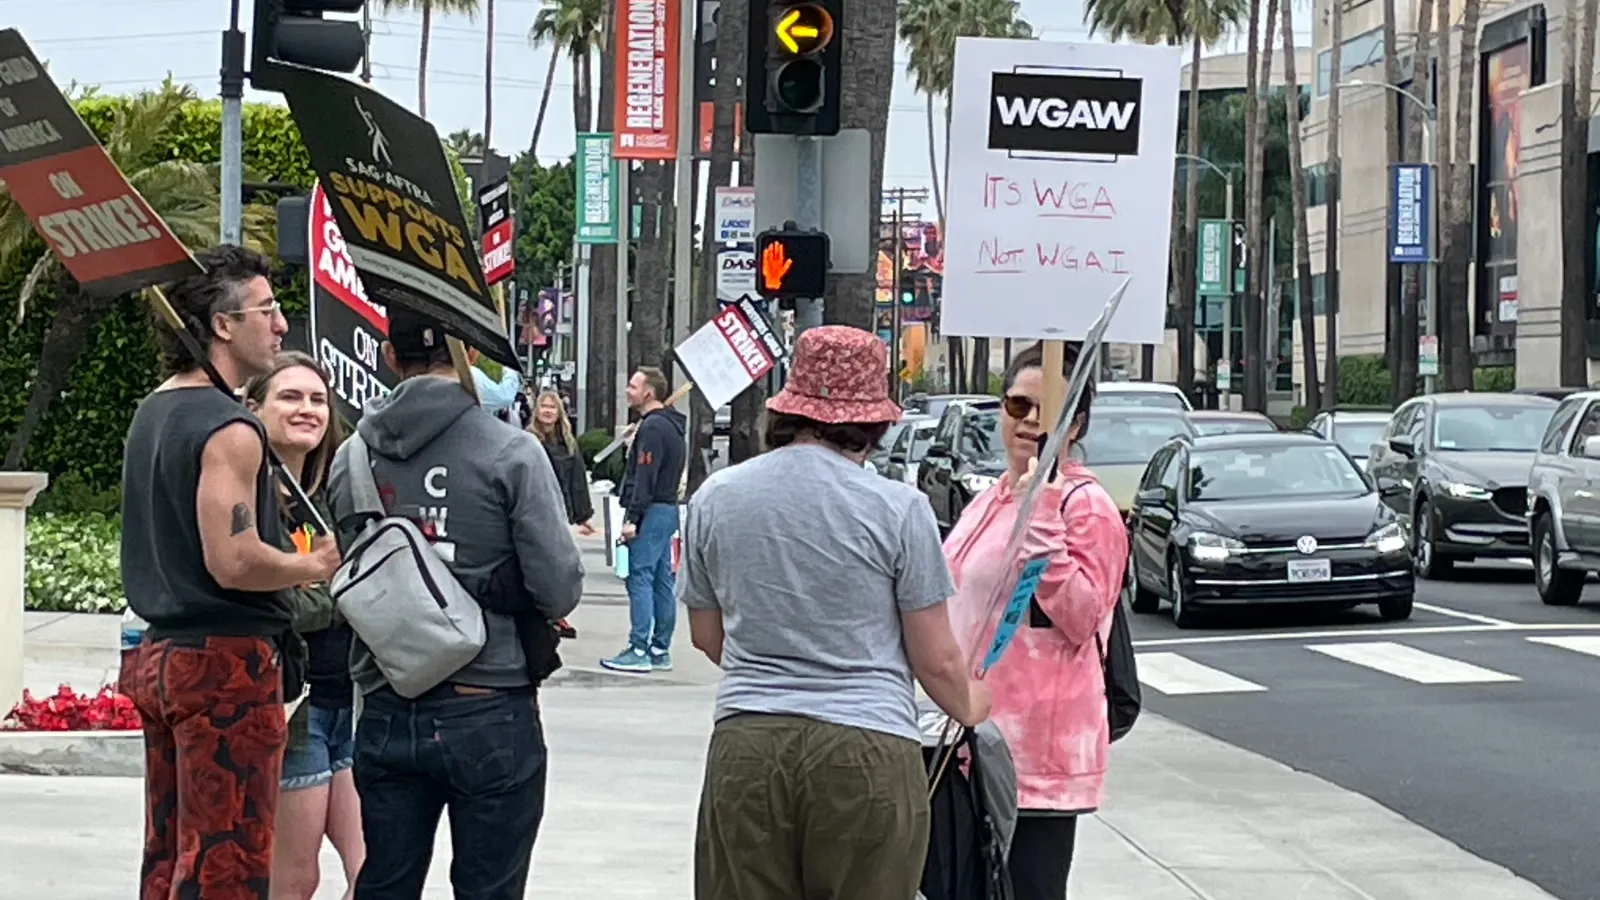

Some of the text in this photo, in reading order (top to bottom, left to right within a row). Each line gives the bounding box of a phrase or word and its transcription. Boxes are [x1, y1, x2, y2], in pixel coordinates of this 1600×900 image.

[995, 96, 1136, 131] WGAW
[49, 171, 84, 199] ON
[1033, 178, 1117, 215] WGA
[39, 194, 162, 258] STRIKE!
[329, 171, 465, 249] SUPPORTS
[336, 195, 483, 296] WGA
[722, 259, 757, 271] DAS
[354, 326, 379, 371] ON
[717, 311, 769, 375] STRIKE!
